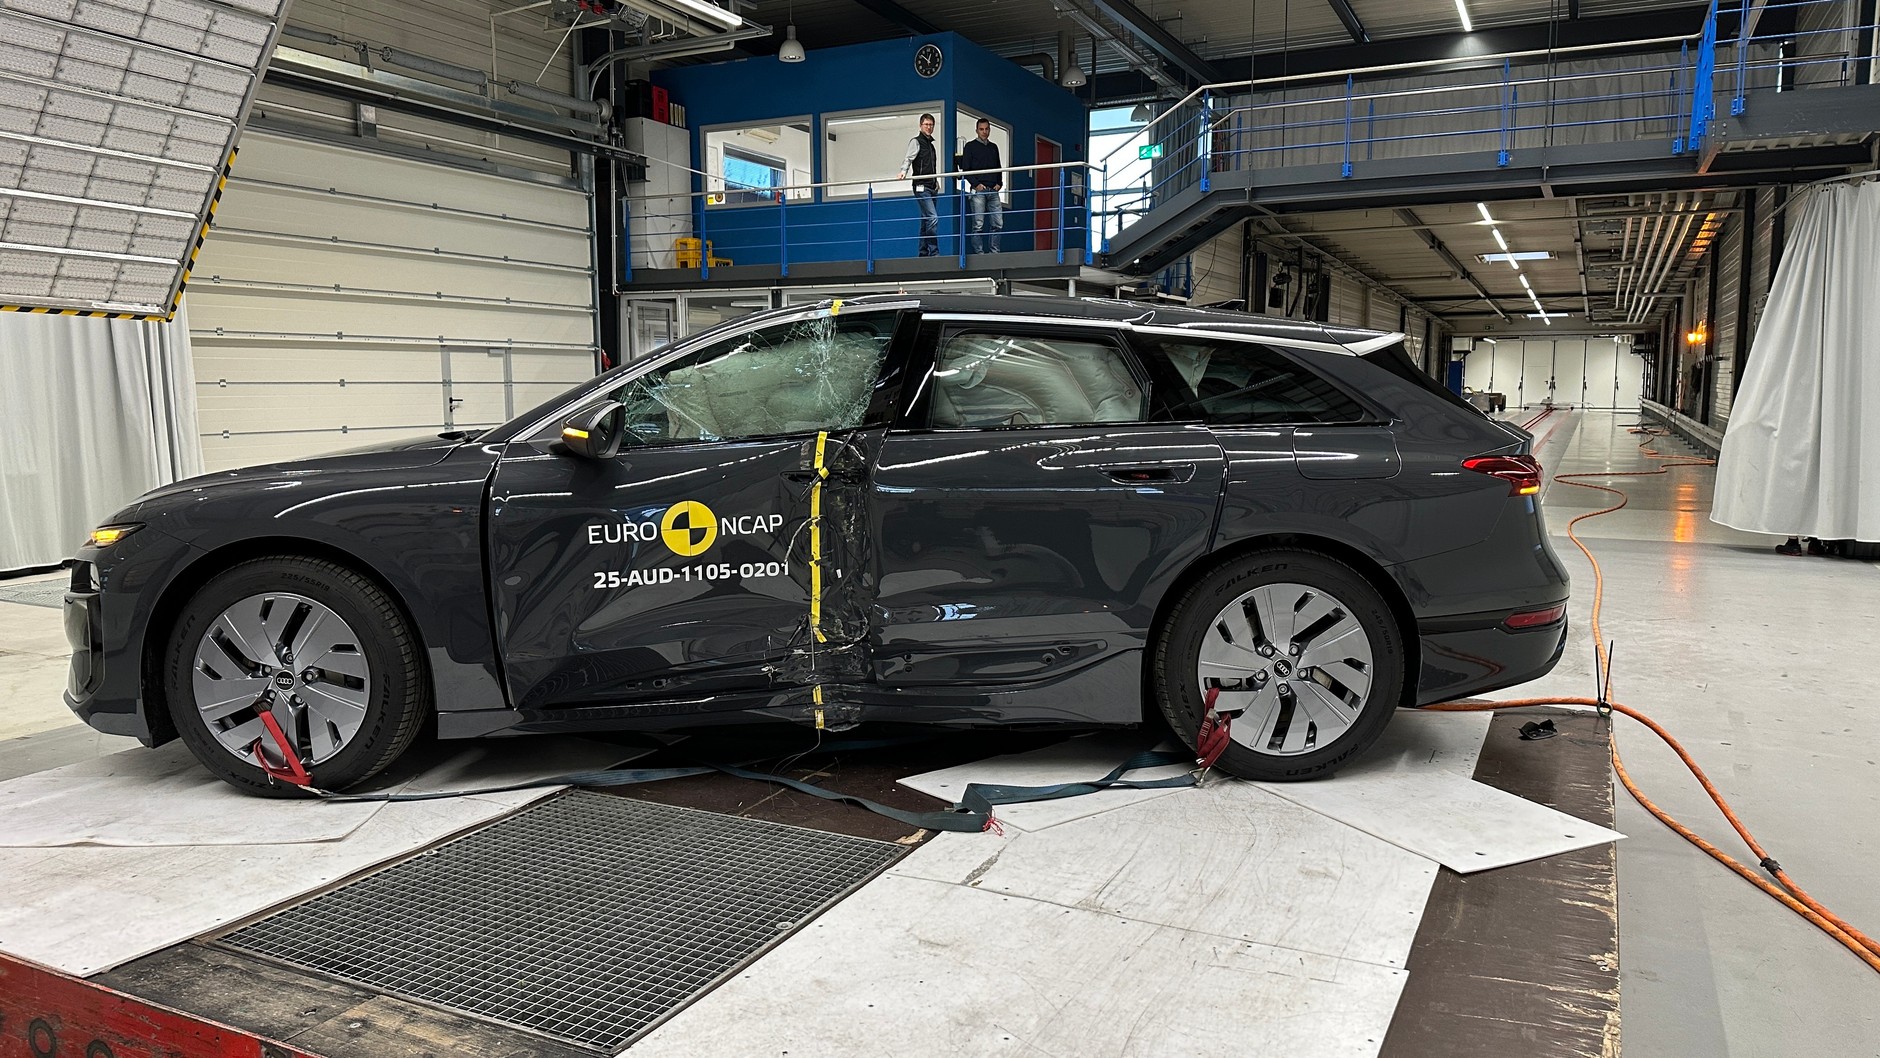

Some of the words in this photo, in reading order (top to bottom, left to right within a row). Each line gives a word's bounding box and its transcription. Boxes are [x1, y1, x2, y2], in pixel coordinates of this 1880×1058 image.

[587, 521, 658, 545] EURO
[721, 514, 784, 536] NCAP
[1214, 563, 1288, 596] FALKEN
[363, 671, 392, 750] FALKEN
[1285, 744, 1360, 776] FALKEN
